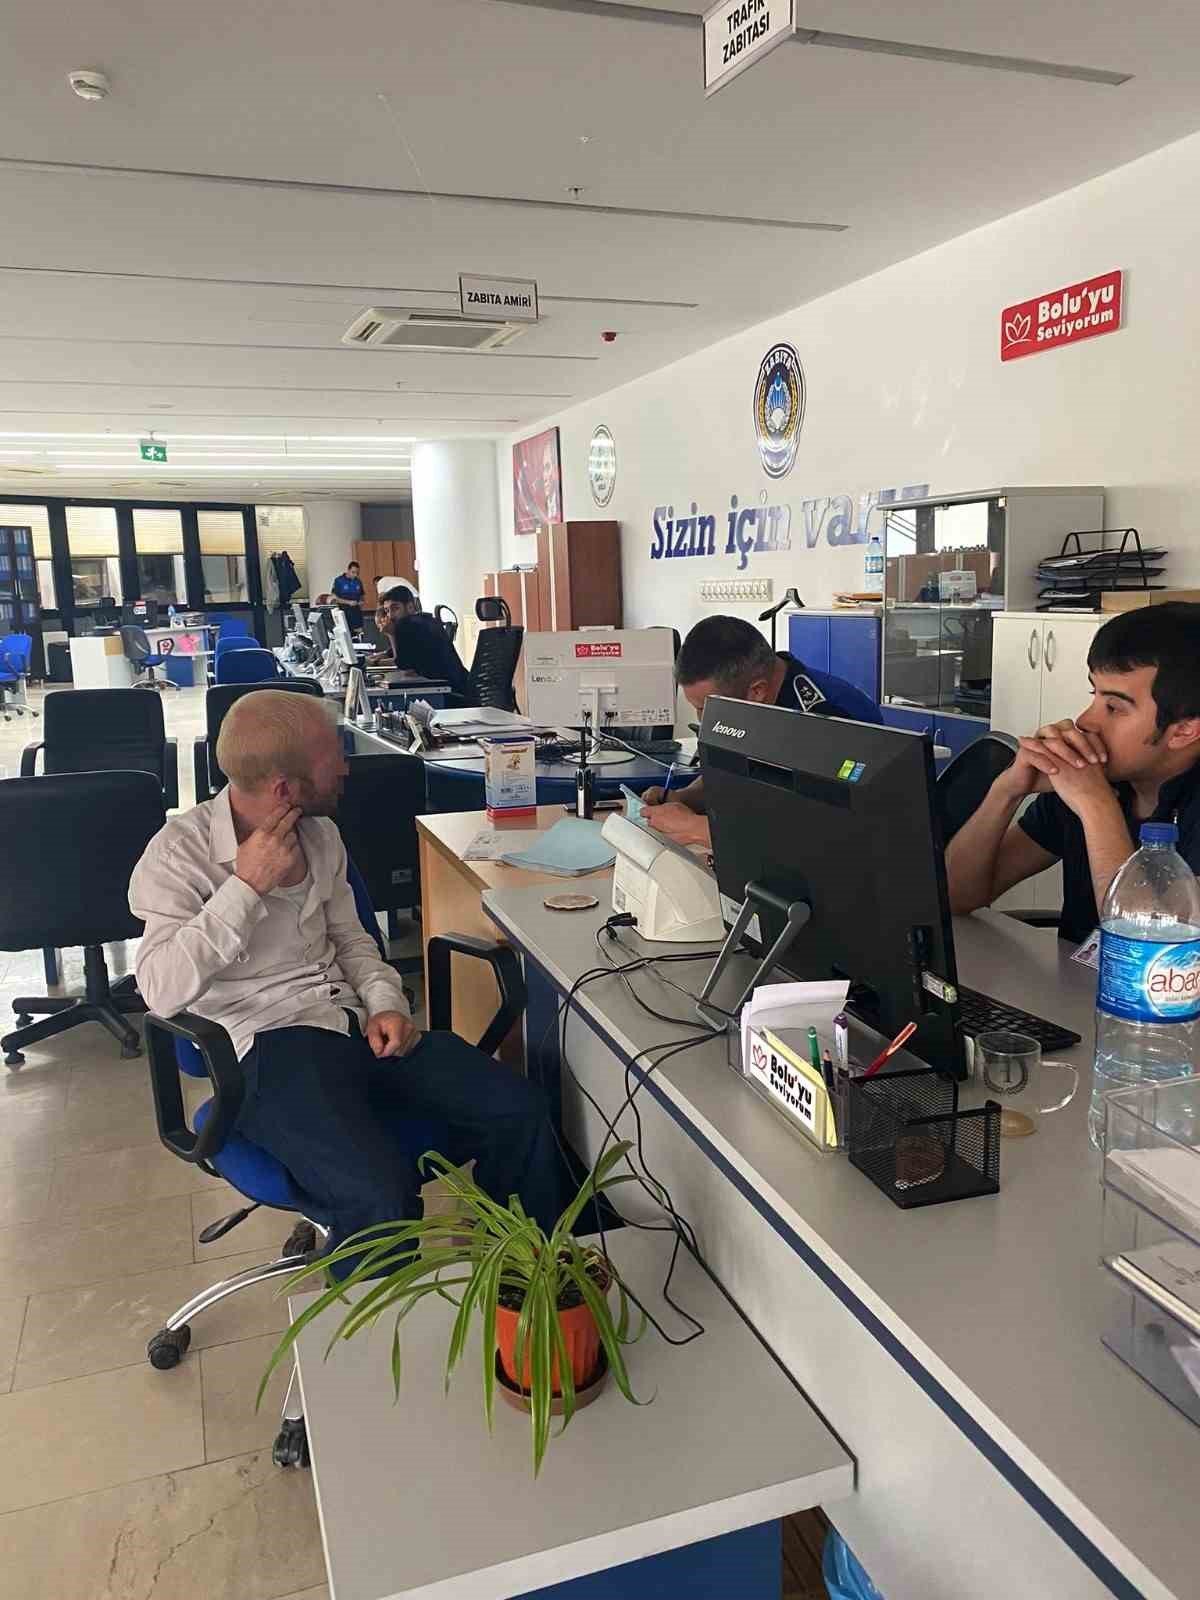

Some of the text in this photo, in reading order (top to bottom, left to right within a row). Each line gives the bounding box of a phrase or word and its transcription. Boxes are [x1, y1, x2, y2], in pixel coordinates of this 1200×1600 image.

[723, 12, 770, 64] ZABITASI
[467, 292, 502, 305] ZABITA
[1038, 284, 1114, 324] Bolu'yu
[1036, 309, 1114, 342] Seviyorum
[651, 502, 716, 560] Sizin
[725, 488, 792, 570] için
[711, 720, 746, 739] lenovo
[769, 1073, 812, 1121] Seviyorum
[770, 1054, 812, 1106] Bolu'yu
